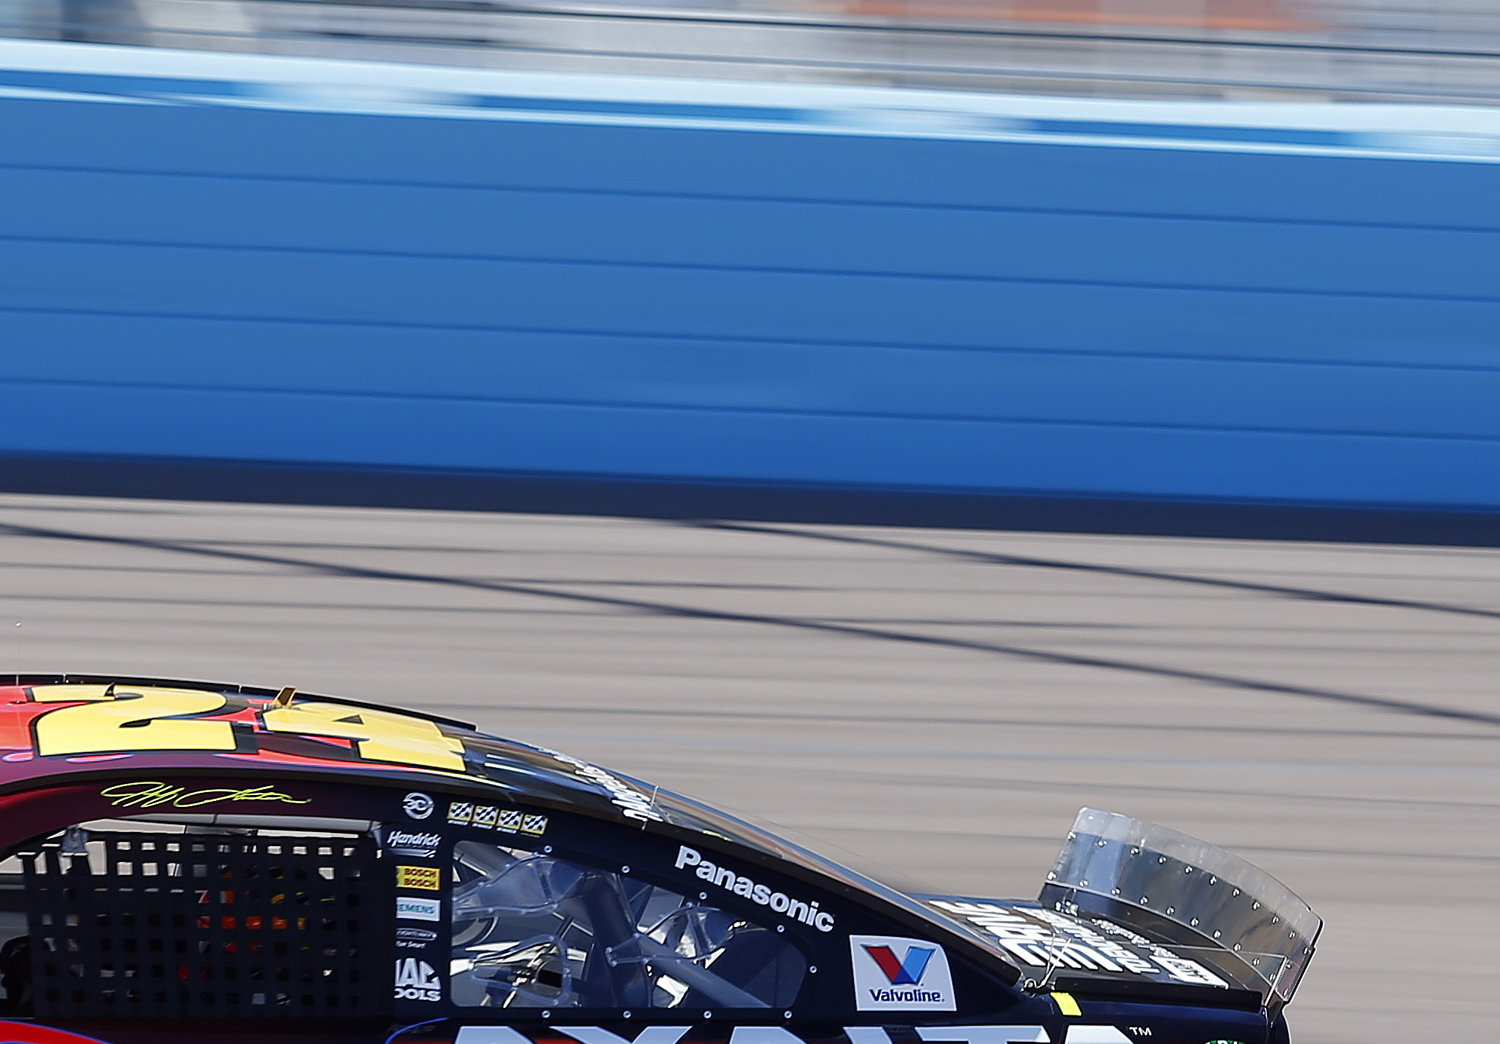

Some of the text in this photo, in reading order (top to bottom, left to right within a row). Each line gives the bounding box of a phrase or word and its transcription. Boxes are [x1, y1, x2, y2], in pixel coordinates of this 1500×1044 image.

[31, 684, 466, 772] 24
[387, 831, 441, 847] Hendrick
[404, 868, 437, 878] BOSCH
[404, 878, 437, 888] BOSCH
[674, 845, 835, 933] Panasonic
[869, 989, 941, 1002] Valvoline
